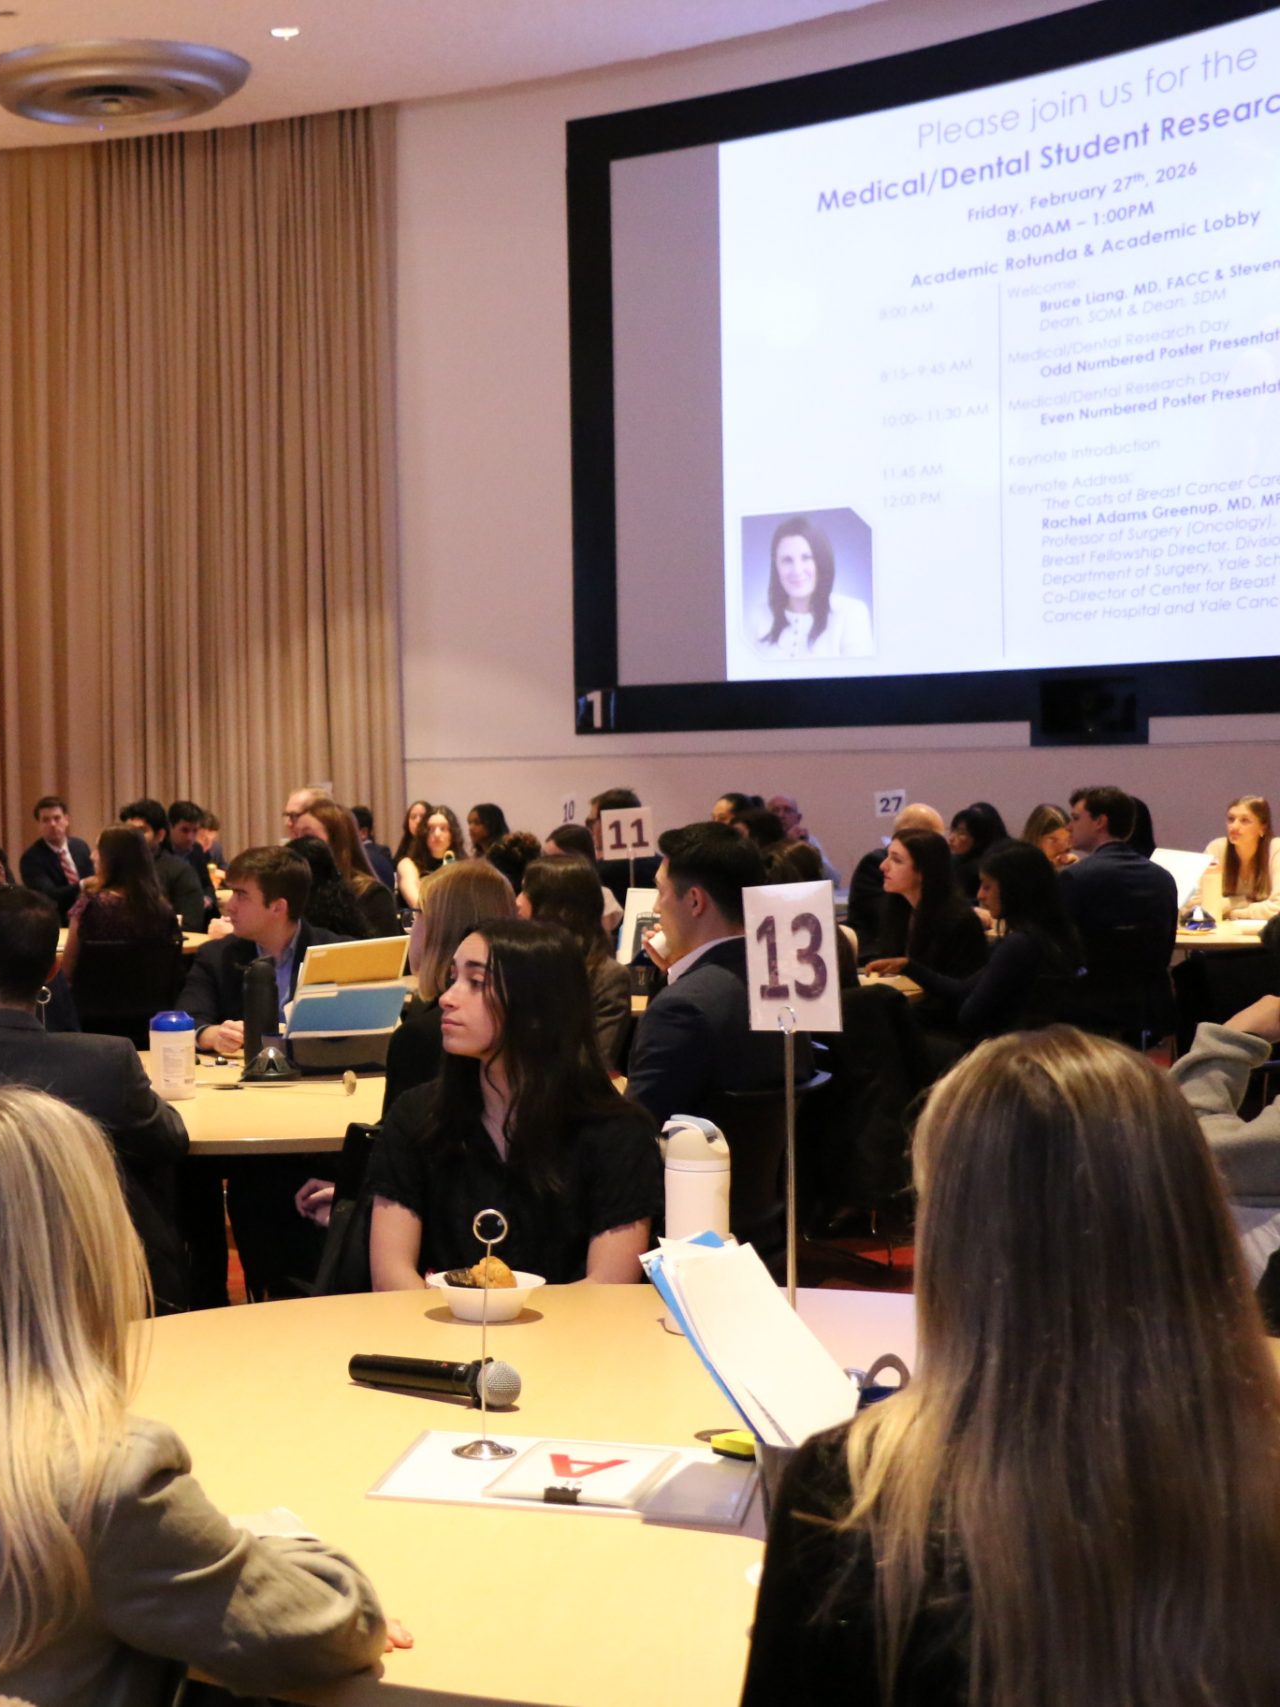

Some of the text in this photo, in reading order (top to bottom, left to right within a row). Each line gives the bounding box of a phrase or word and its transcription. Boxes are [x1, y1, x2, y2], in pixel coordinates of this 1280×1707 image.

[918, 47, 1258, 149] Please join us for the
[816, 93, 1280, 213] Medical/Dental Student Researc
[968, 203, 1023, 223] Friday,
[1030, 184, 1107, 211] February
[1155, 161, 1198, 184] 2026
[1006, 218, 1071, 243] 8:00AM
[1093, 201, 1155, 226] 1:00PM
[910, 209, 1261, 288] Academic Rotunda & Academic Lobby
[1040, 297, 1081, 312] Bruce
[1167, 271, 1210, 290] FACC
[1215, 269, 1224, 282] &
[1007, 319, 1230, 363] Medical/Dental Research Day
[1040, 362, 1071, 378] Odd
[1076, 350, 1154, 372] Numbered
[1160, 342, 1205, 360] Poster
[1007, 370, 1230, 411] Medical/Dental Research Day
[1040, 412, 1075, 426] Even
[1079, 397, 1157, 421] Numbered
[1162, 392, 1207, 410] Poster
[1074, 491, 1113, 508] Costs
[1117, 489, 1133, 504] of
[1136, 483, 1181, 501] Breast
[1185, 479, 1244, 496] Cancer
[1041, 512, 1091, 529] Rachel
[1096, 509, 1148, 525] Adams
[1041, 533, 1104, 548] Professor
[1108, 528, 1123, 543] of
[1127, 525, 1182, 542] Surgery
[1041, 552, 1086, 568] Breast
[1090, 546, 1164, 563] Fellowship
[1041, 566, 1131, 587] Department
[1135, 563, 1150, 579] of
[1218, 555, 1251, 571] Yale
[1130, 583, 1146, 599] of
[1149, 580, 1201, 597] Center
[1205, 577, 1225, 592] for
[1229, 573, 1276, 590] Breast
[1042, 607, 1098, 623] Cancer
[1102, 602, 1161, 621] Hospital
[1164, 599, 1195, 615] and
[1199, 597, 1232, 613] Yale
[563, 800, 575, 823] 10
[880, 796, 902, 813] 27
[608, 818, 649, 850] 11
[756, 912, 828, 1001] 13
